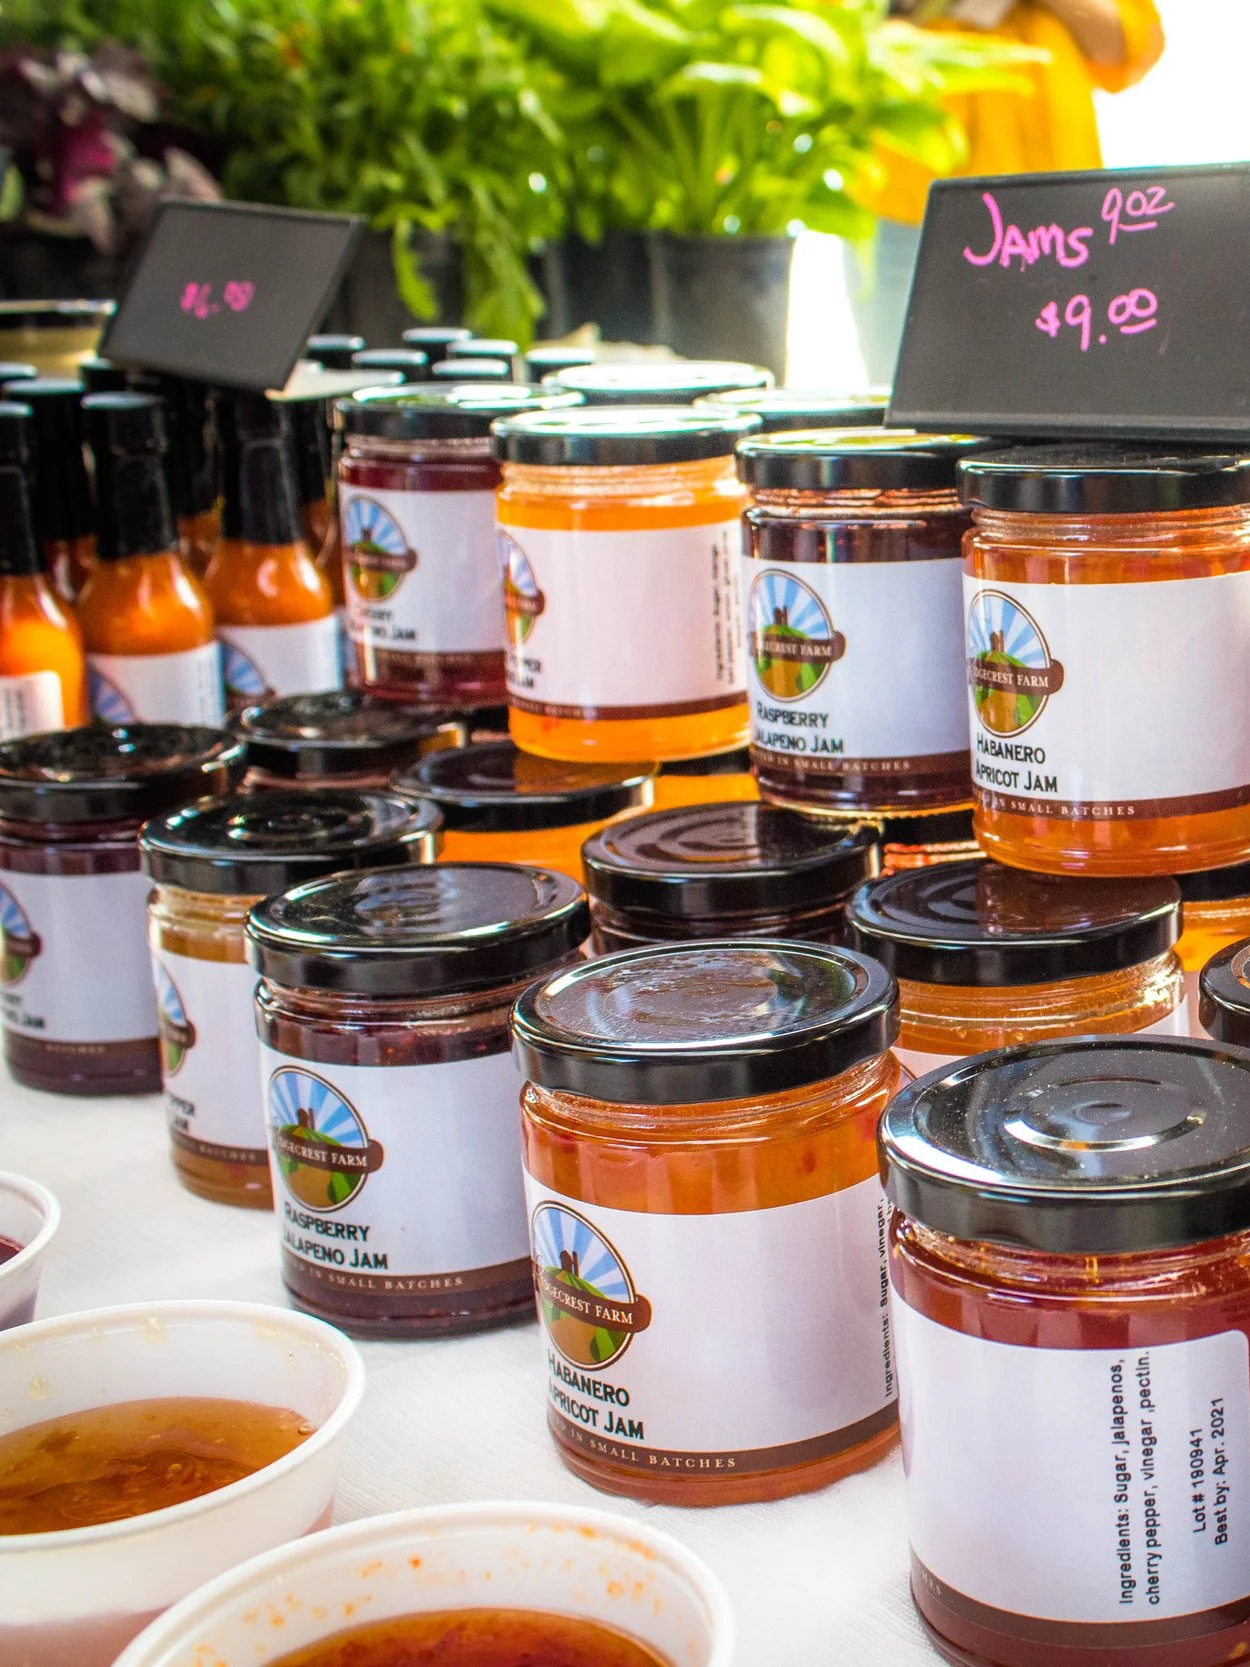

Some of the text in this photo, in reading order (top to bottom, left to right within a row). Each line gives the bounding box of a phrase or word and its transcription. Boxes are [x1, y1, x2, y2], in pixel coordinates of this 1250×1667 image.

[1017, 674, 1049, 687] FARM
[756, 701, 829, 729] RASPBERRY
[811, 736, 844, 753] JAM
[976, 732, 1046, 765] HABANERO
[842, 761, 910, 771] BATCHES
[976, 759, 1058, 793] APRICOT JAM
[1011, 800, 1053, 814] SMALL
[1061, 806, 1135, 816] BATCHES
[331, 1153, 367, 1167] FARM
[284, 1201, 370, 1241] RASPBERRY
[349, 1249, 388, 1270] JAM
[328, 1273, 376, 1289] SMALL
[384, 1276, 463, 1290] BATCHES
[877, 1198, 893, 1396] Ingredients: Sugar, vinegar,
[595, 1305, 633, 1324] FARM
[548, 1350, 630, 1407] HABANERO
[603, 1411, 644, 1440] JAM
[571, 1429, 736, 1468] IN SMALL BATCHES
[1140, 1419, 1157, 1480] vinegar
[1111, 1359, 1136, 1604] Ingredients: Sugar, jalapenos,
[1190, 1428, 1206, 1533] Lot # 190941
[1211, 1398, 1230, 1545] Best by: Apr. 2021
[1143, 1485, 1160, 1549] pepper,
[1146, 1551, 1162, 1605] cherry
